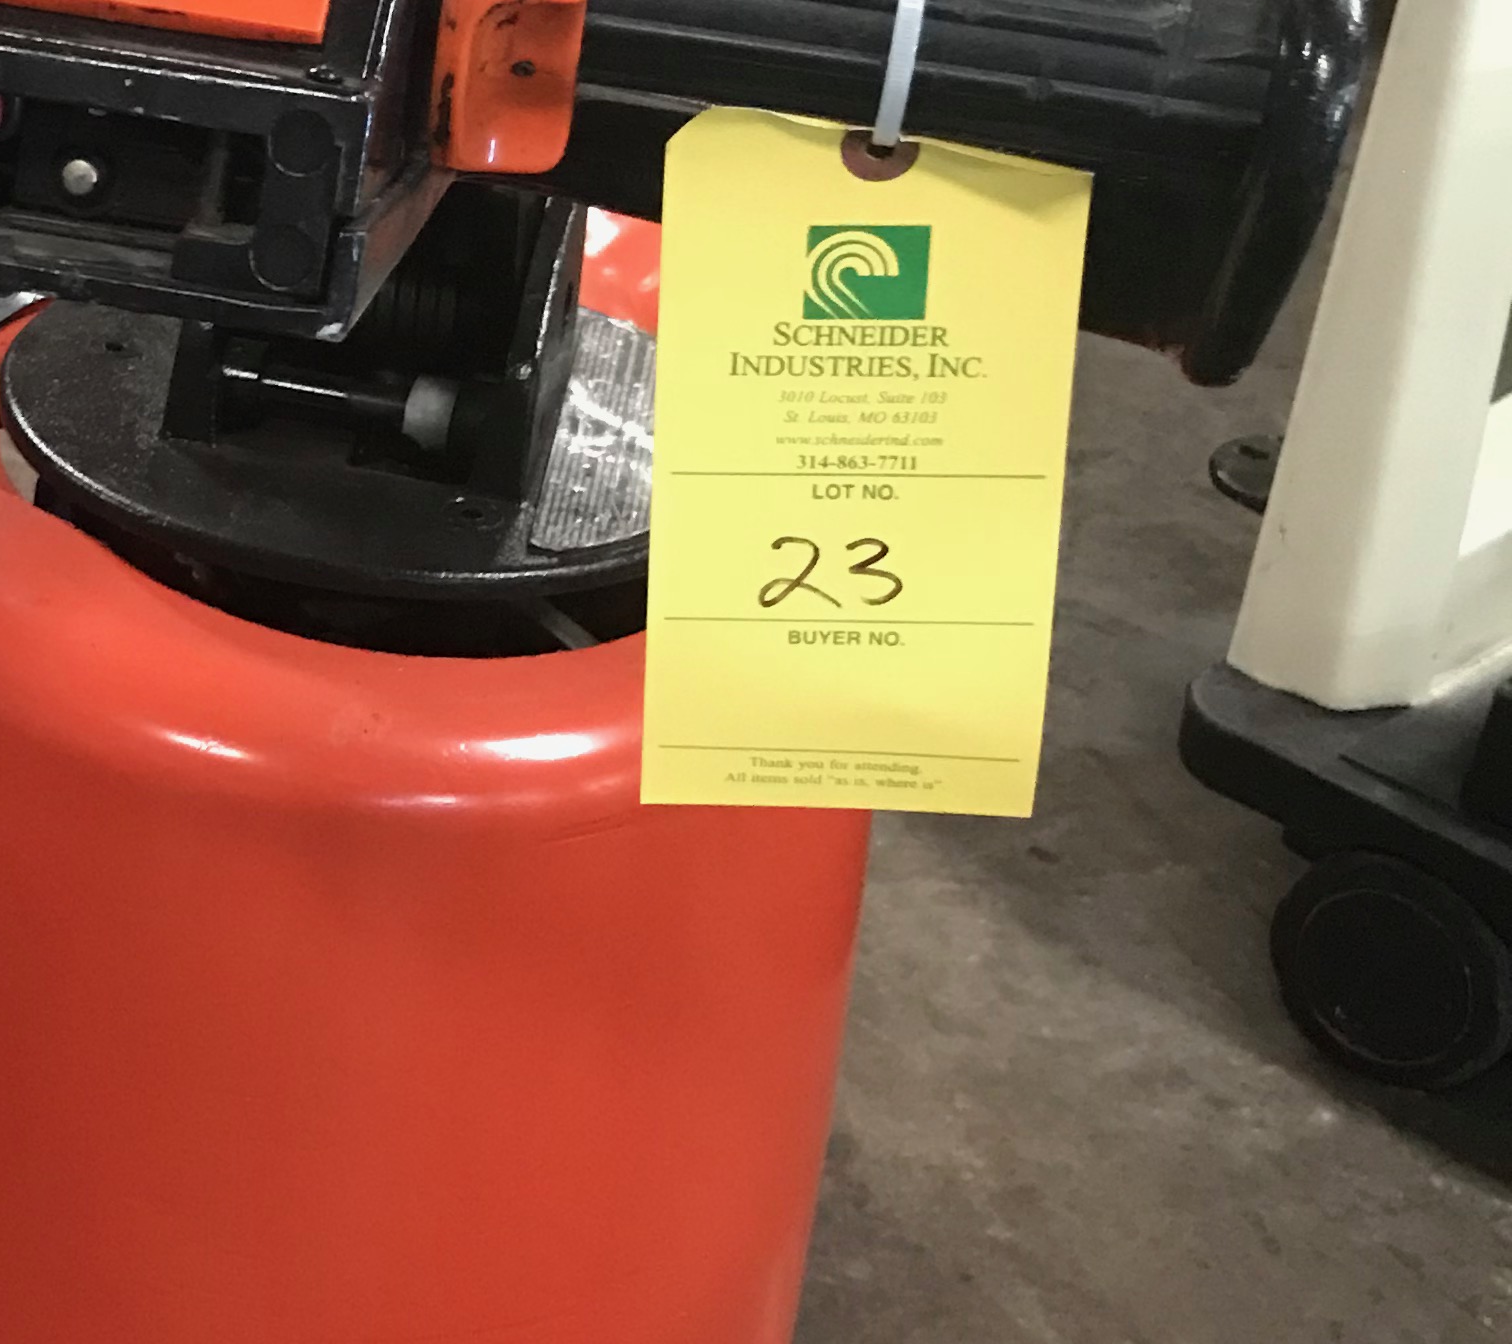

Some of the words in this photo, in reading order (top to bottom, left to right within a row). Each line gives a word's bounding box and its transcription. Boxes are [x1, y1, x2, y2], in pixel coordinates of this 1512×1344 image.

[772, 321, 950, 348] SCHNEIDER
[728, 351, 920, 381] INDUSTRIES,
[926, 353, 988, 378] INC.
[777, 390, 815, 404] 3010
[877, 391, 916, 404] Suite
[921, 391, 948, 405] 103
[858, 411, 887, 424] MO
[891, 411, 938, 425] 63103
[796, 454, 918, 471] 314-863-7711
[811, 483, 856, 500] LOT
[862, 483, 900, 501] NO.
[758, 536, 903, 608] 23
[787, 630, 862, 645] BUYER
[869, 631, 906, 647] NO.
[750, 756, 793, 769] Thank
[798, 760, 825, 772] you
[830, 759, 849, 770] for
[751, 773, 788, 784] items
[793, 774, 822, 785] sold
[875, 777, 918, 789] where
